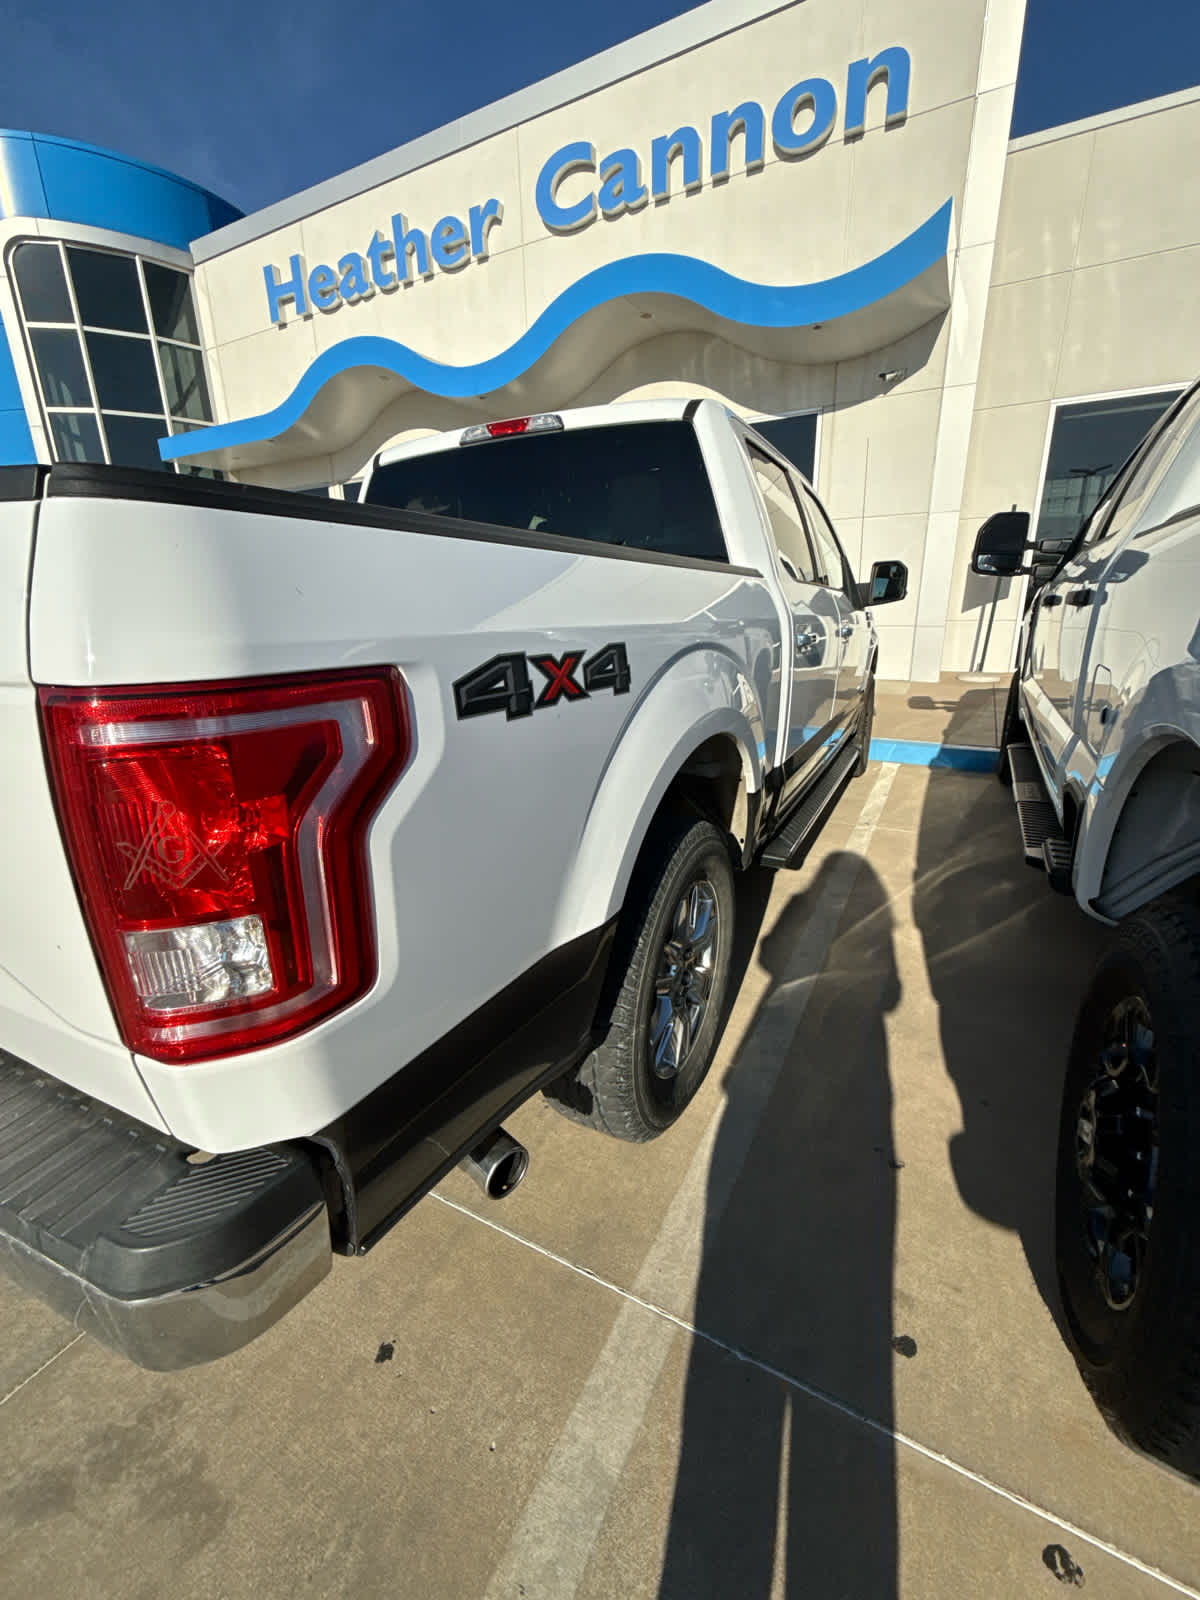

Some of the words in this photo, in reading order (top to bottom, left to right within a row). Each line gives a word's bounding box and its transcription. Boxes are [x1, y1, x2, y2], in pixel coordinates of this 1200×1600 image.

[263, 197, 504, 328] Heather
[535, 46, 911, 237] Cannon
[157, 835, 185, 864] G
